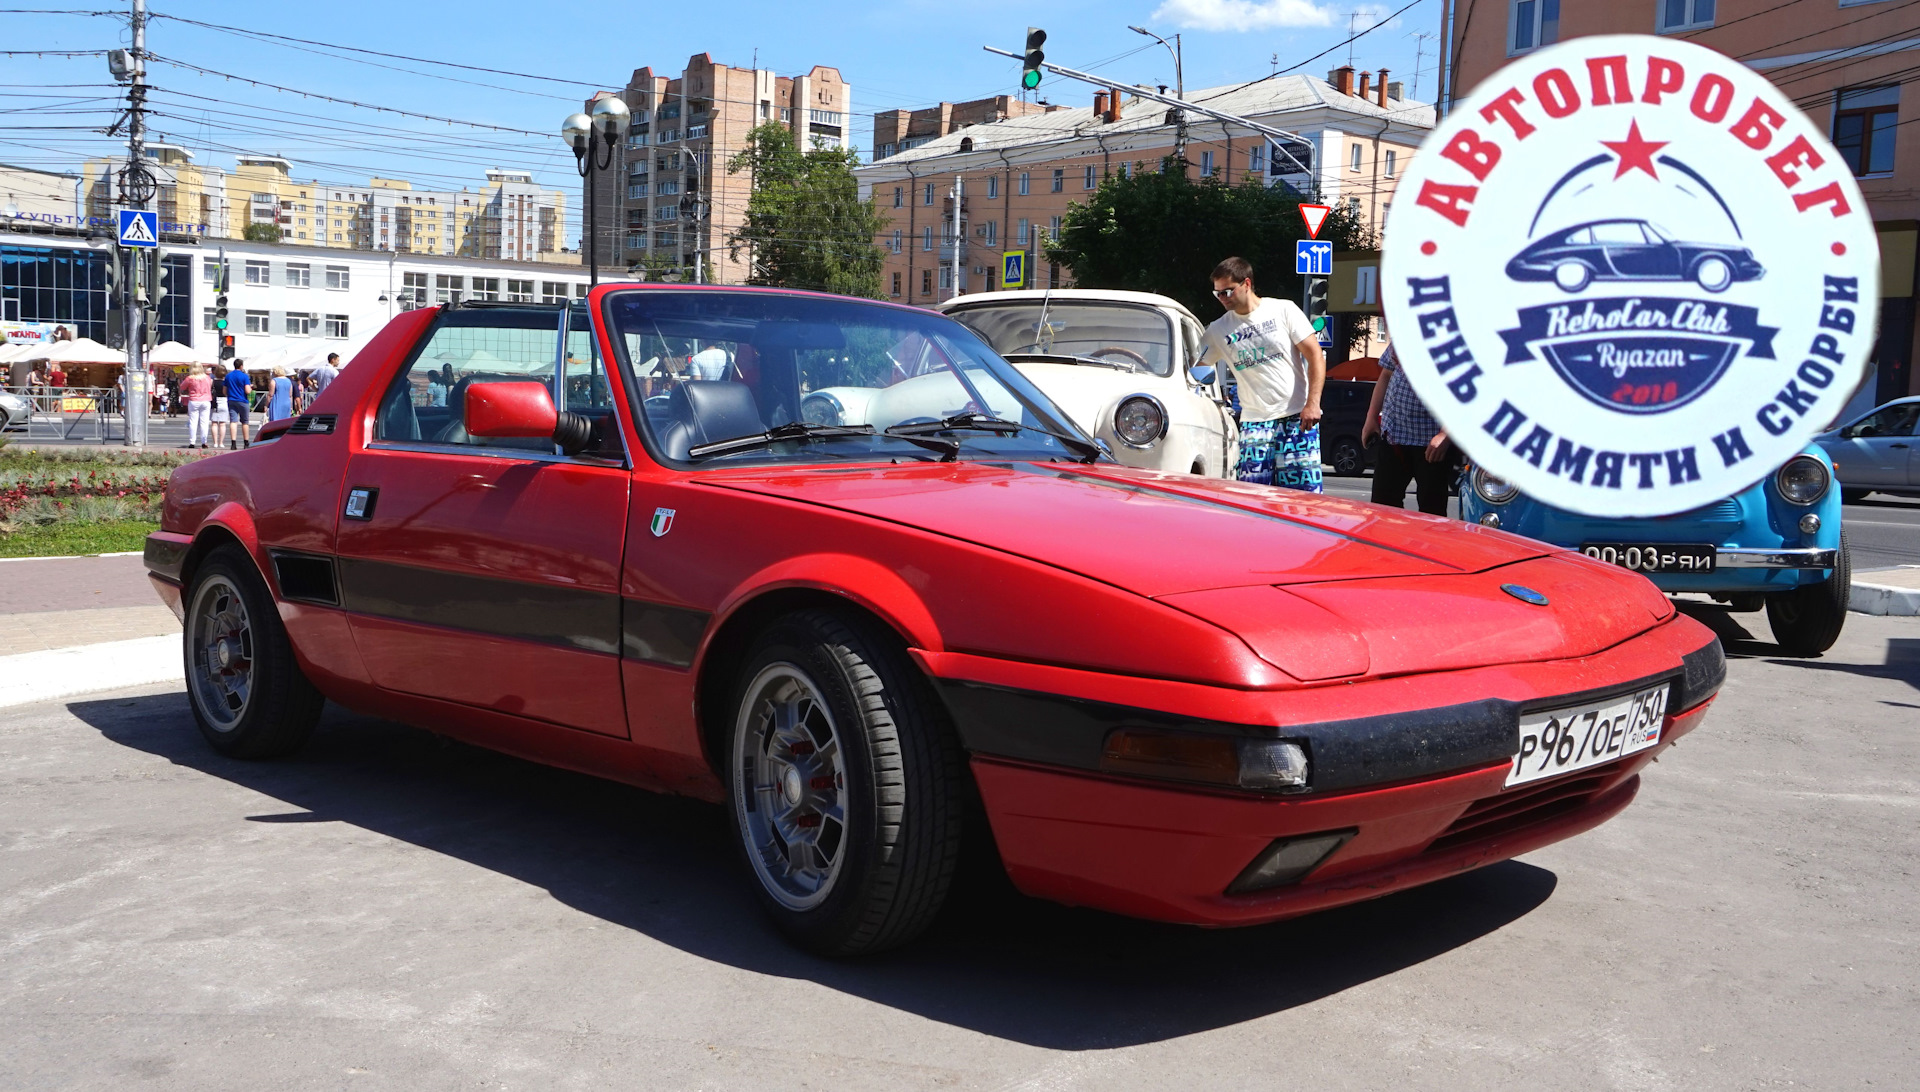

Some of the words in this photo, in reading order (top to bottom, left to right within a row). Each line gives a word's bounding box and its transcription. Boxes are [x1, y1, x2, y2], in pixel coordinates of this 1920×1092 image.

[158, 221, 206, 233] ЕНТР
[1629, 690, 1663, 735] 750
[1631, 730, 1647, 746] RUS
